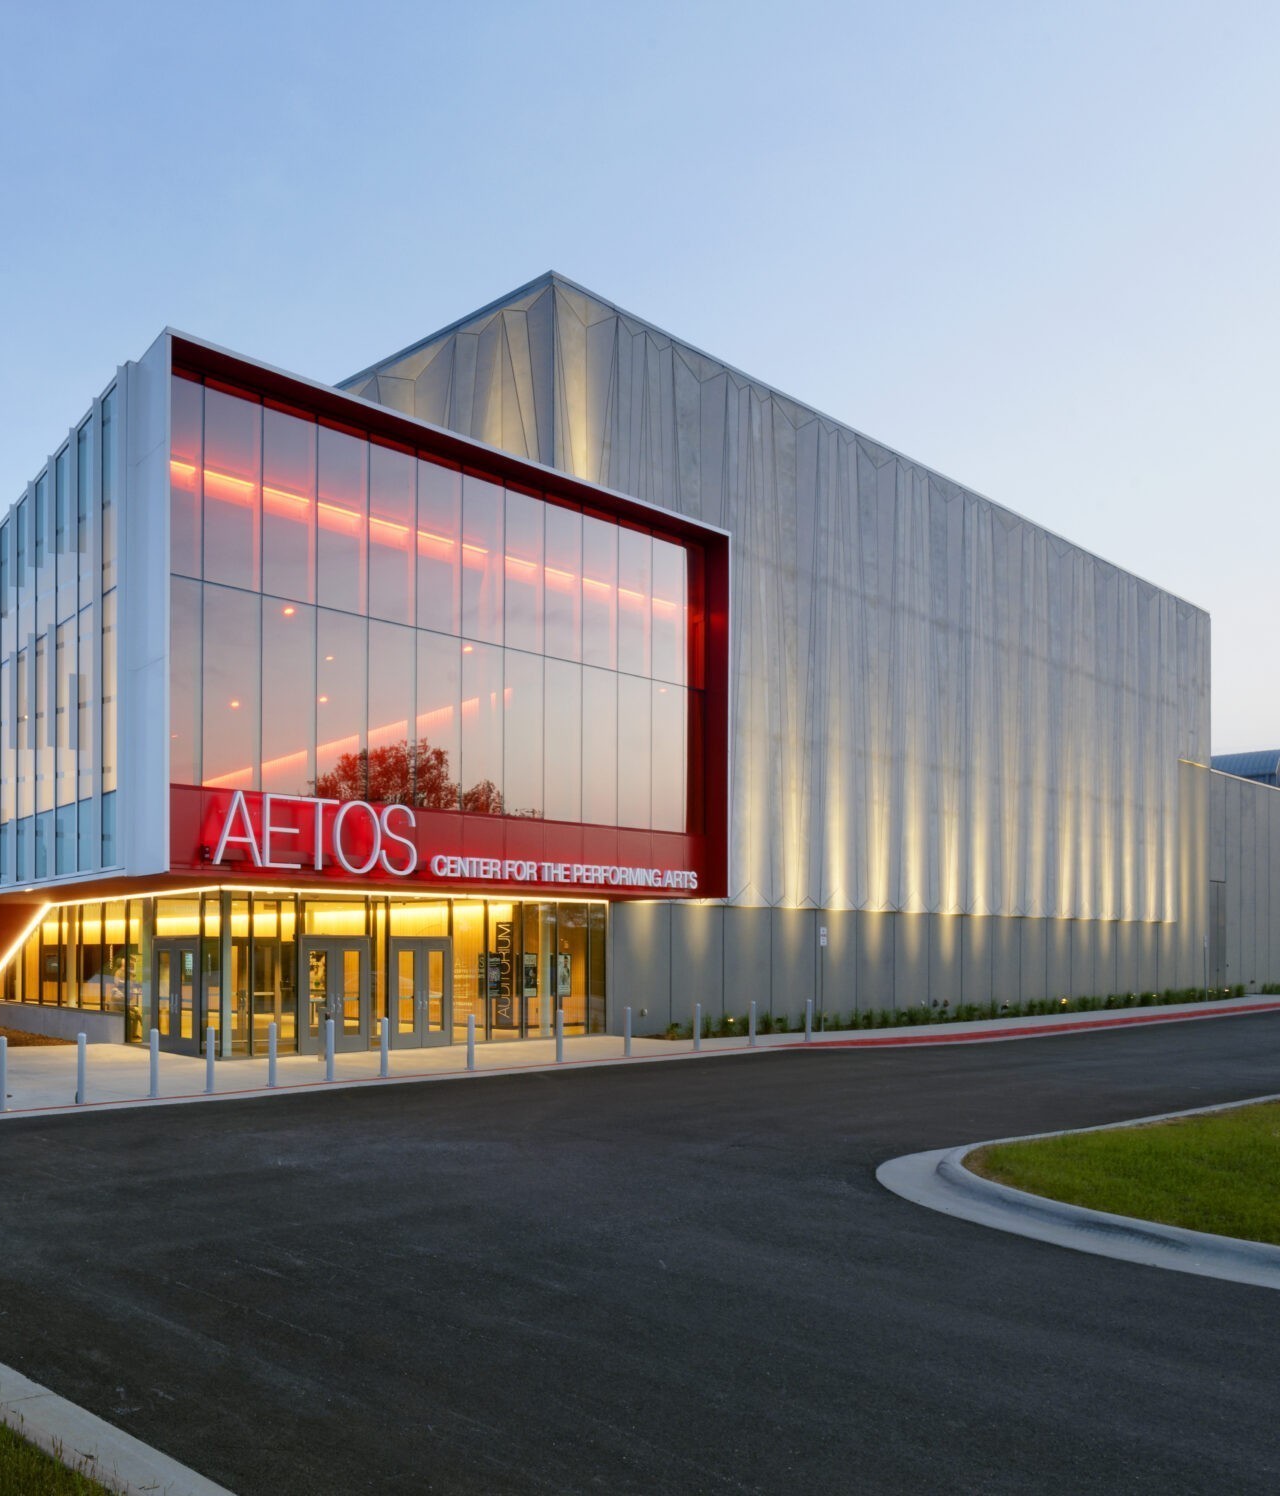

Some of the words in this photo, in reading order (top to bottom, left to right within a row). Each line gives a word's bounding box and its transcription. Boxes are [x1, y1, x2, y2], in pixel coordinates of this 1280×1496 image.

[212, 790, 417, 876] AETOS
[431, 855, 502, 880] CENTER
[503, 860, 538, 882] FOR
[541, 862, 570, 884] THE
[572, 864, 662, 887] PERFORMING
[663, 870, 698, 889] ARTS
[497, 923, 511, 1018] AUDITORIUM
